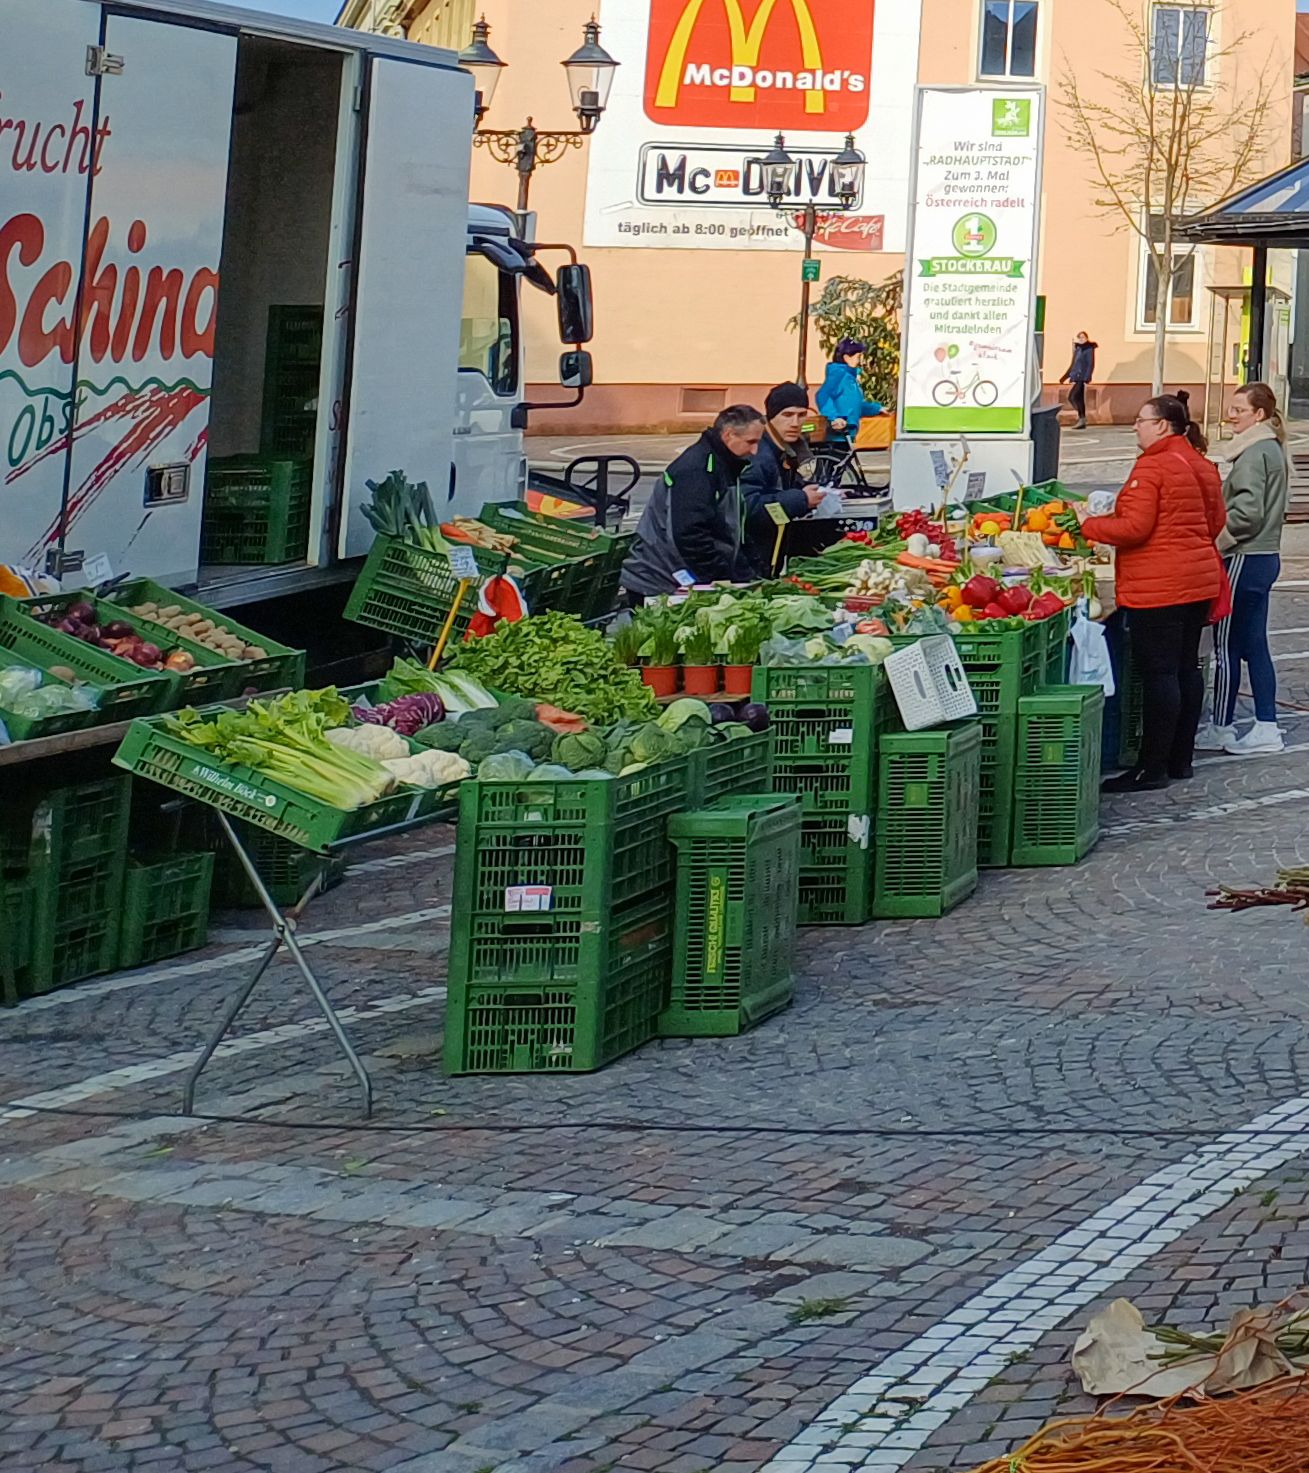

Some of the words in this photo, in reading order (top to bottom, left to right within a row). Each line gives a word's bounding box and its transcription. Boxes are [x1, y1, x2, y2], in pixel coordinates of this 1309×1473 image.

[683, 63, 865, 92] McDonald's
[954, 141, 976, 152] Wir
[978, 141, 1003, 152] sind
[656, 152, 711, 196] Mc
[742, 156, 859, 197] DIV
[944, 170, 971, 181] Zum
[987, 170, 1010, 181] Mal
[925, 193, 988, 208] Österreich
[991, 197, 1025, 208] radelt
[617, 221, 668, 236] täglich
[672, 223, 691, 235] ab
[694, 223, 726, 236] 8:00
[730, 224, 789, 238] geöffnet
[923, 282, 939, 293] Die
[941, 282, 1018, 295] Stadtgemeinde
[924, 296, 972, 308] gratuliert
[975, 296, 1015, 307] herzlich
[930, 311, 949, 320] und
[952, 311, 981, 320] dankt
[983, 311, 1008, 320] allen
[934, 324, 1002, 334] Mitradelnden
[8, 388, 88, 467] Obst
